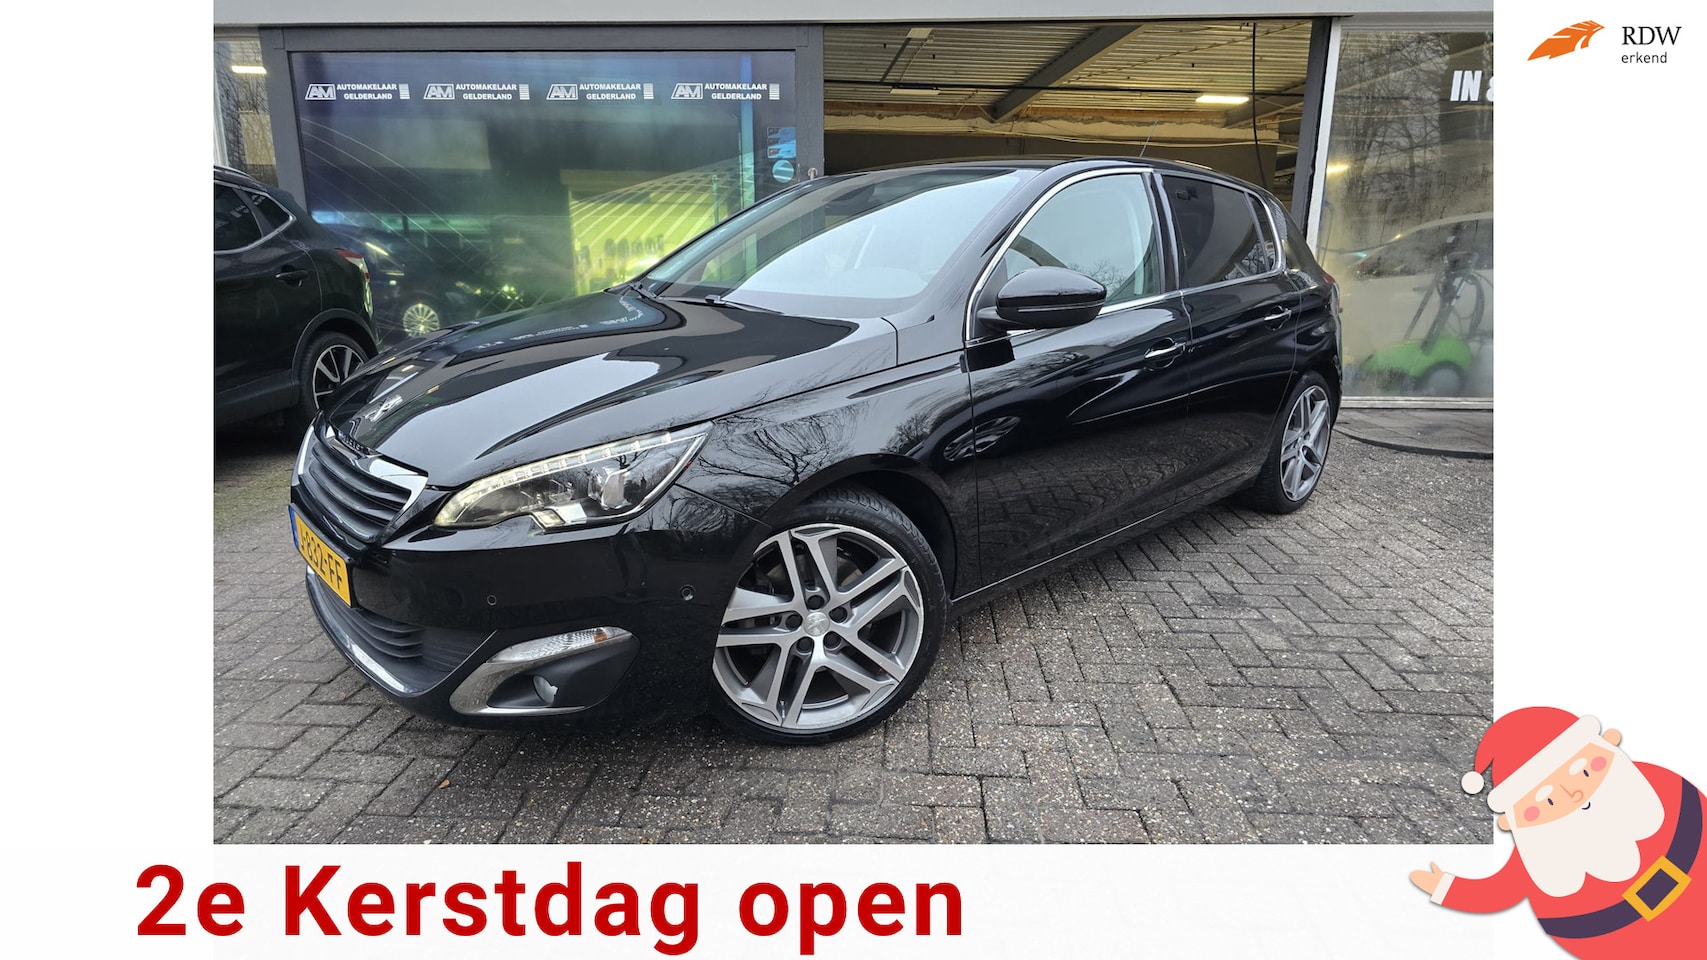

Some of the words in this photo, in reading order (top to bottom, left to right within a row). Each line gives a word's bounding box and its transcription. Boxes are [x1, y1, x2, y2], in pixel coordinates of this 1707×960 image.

[336, 83, 397, 91] AUTOMAKELAAR
[455, 83, 518, 91] AUTOMAKELAAR
[578, 83, 641, 91] AUTOMAKELAAR
[704, 83, 768, 91] AUTOMAKELAAR
[1450, 70, 1482, 102] IN
[343, 92, 393, 100] GELDERLAND
[462, 92, 513, 100] GELDERLAND
[586, 92, 636, 100] GELDERLAND
[711, 92, 762, 100] GELDERLAND
